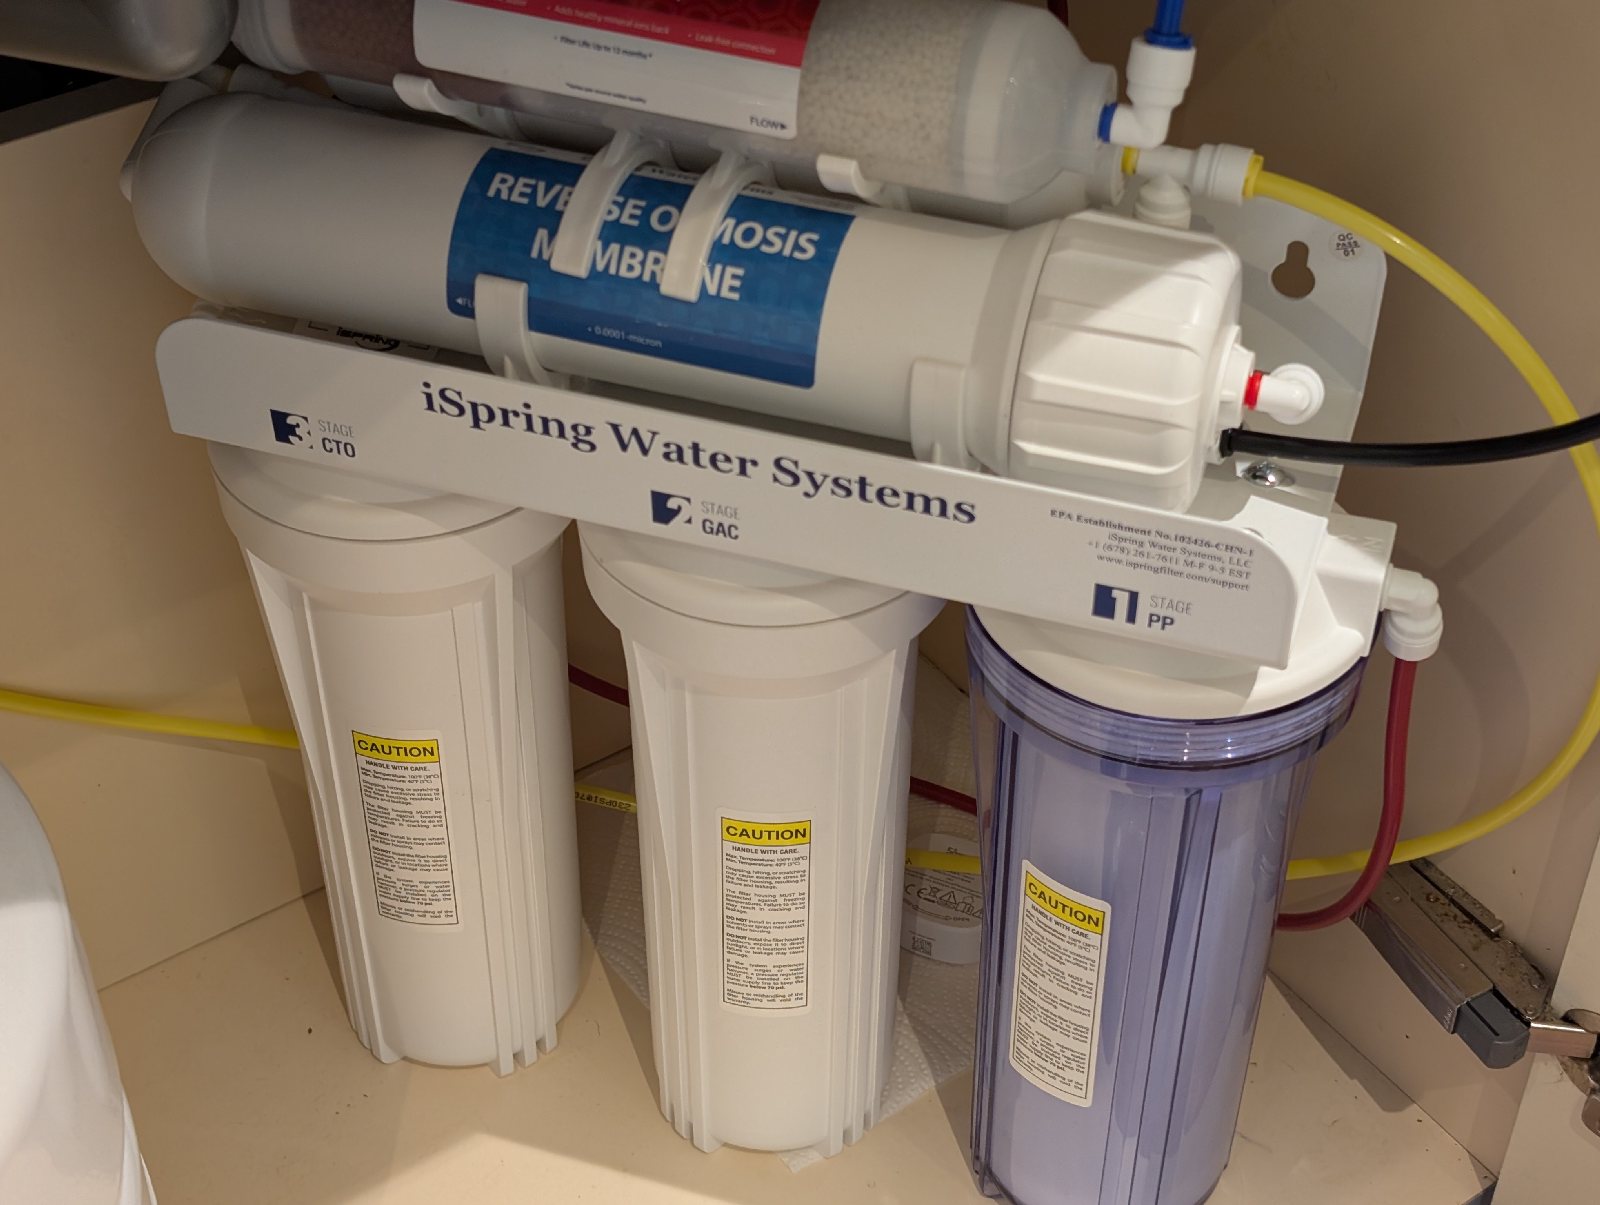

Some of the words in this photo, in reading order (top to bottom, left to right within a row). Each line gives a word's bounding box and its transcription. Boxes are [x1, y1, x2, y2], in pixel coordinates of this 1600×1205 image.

[486, 171, 647, 227] REVESE
[650, 204, 820, 261] OMOSIS
[530, 227, 745, 300] MMBRNE
[318, 419, 354, 438] STAGE
[321, 437, 356, 458] CTO
[420, 381, 598, 453] iSpring
[605, 421, 760, 478] Water
[772, 455, 977, 525] Systems
[700, 500, 740, 521] STAGE
[702, 518, 739, 540] GAC
[1149, 594, 1193, 616] STAGE
[1147, 612, 1175, 631] PP
[358, 740, 435, 757] CAUTION
[725, 825, 807, 841] CAUTION
[732, 846, 758, 854] HANDLE
[1029, 882, 1100, 927] CAUTION
